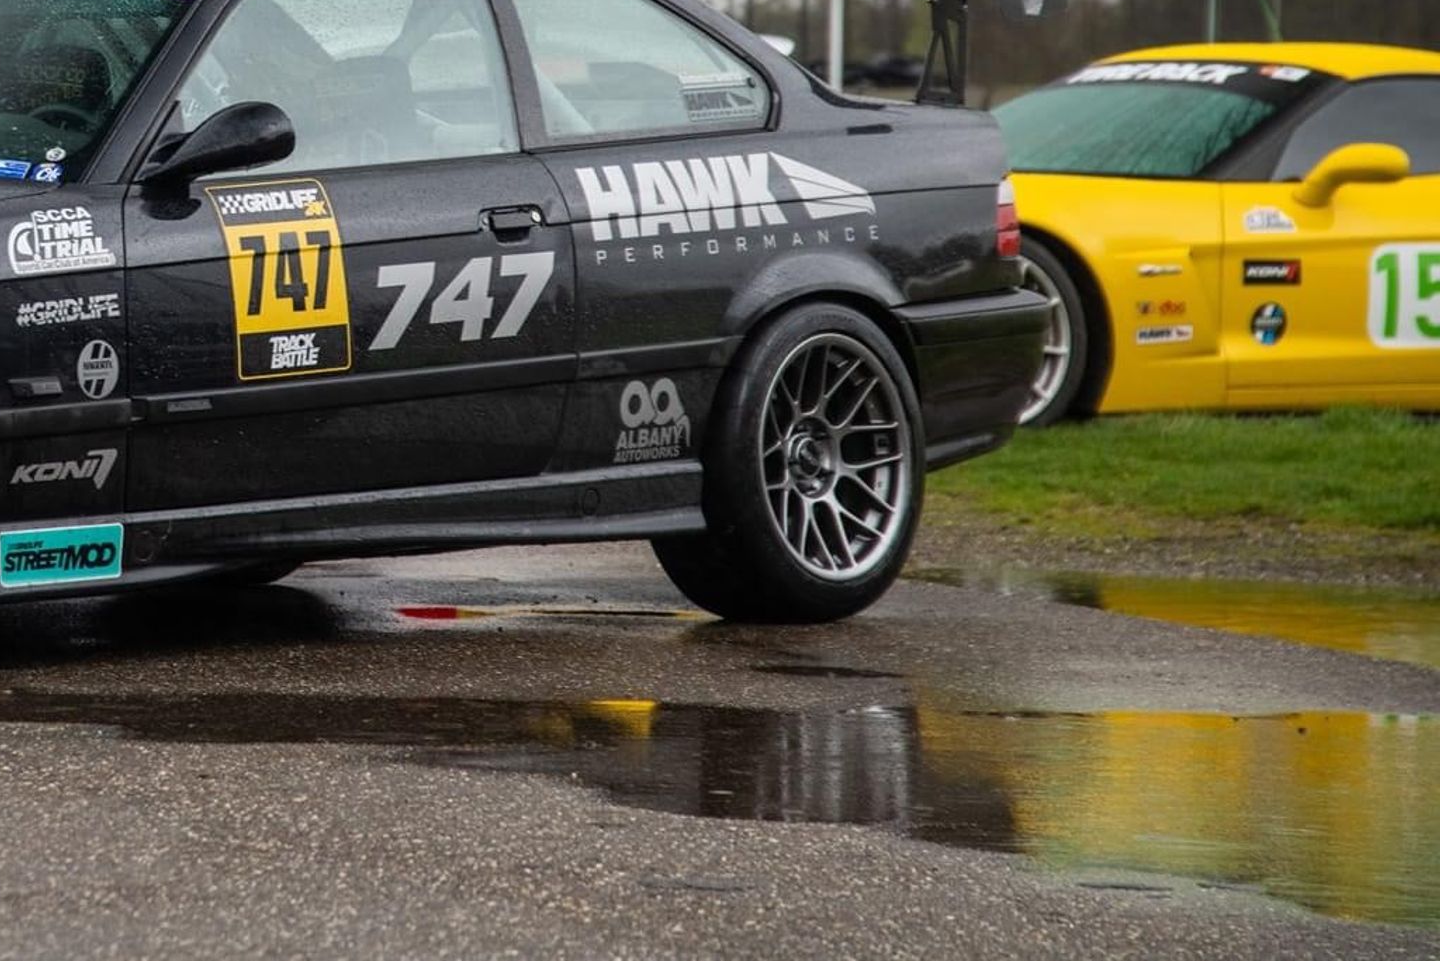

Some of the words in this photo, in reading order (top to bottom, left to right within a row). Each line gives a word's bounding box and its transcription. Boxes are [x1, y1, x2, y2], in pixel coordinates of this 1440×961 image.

[243, 188, 318, 213] GRIDLIFE
[575, 152, 788, 241] HAWK
[32, 206, 91, 222] SCCA
[596, 225, 879, 265] PERFORMANCE
[239, 231, 331, 316] 747
[16, 293, 121, 327] #GRIDLIFE
[368, 251, 555, 351] 747
[269, 332, 316, 354] TRACK
[270, 346, 320, 369] BATTLE
[616, 425, 684, 450] ALBANY
[613, 444, 681, 464] AUTOWORKS
